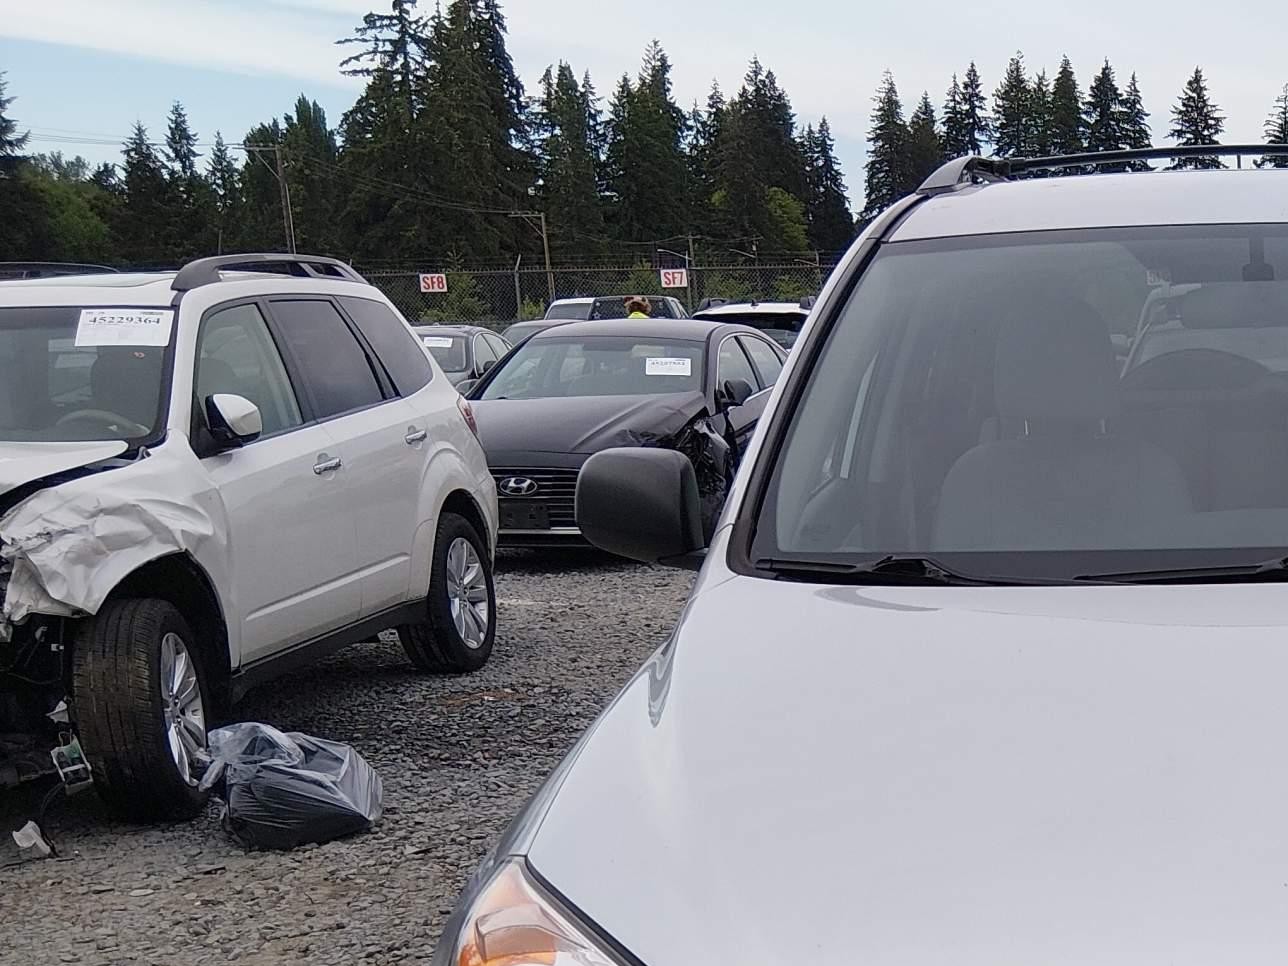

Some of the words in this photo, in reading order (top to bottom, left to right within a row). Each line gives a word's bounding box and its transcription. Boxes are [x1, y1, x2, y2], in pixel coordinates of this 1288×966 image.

[422, 275, 445, 290] SF8
[663, 271, 684, 286] SF7
[89, 316, 161, 325] 45229364
